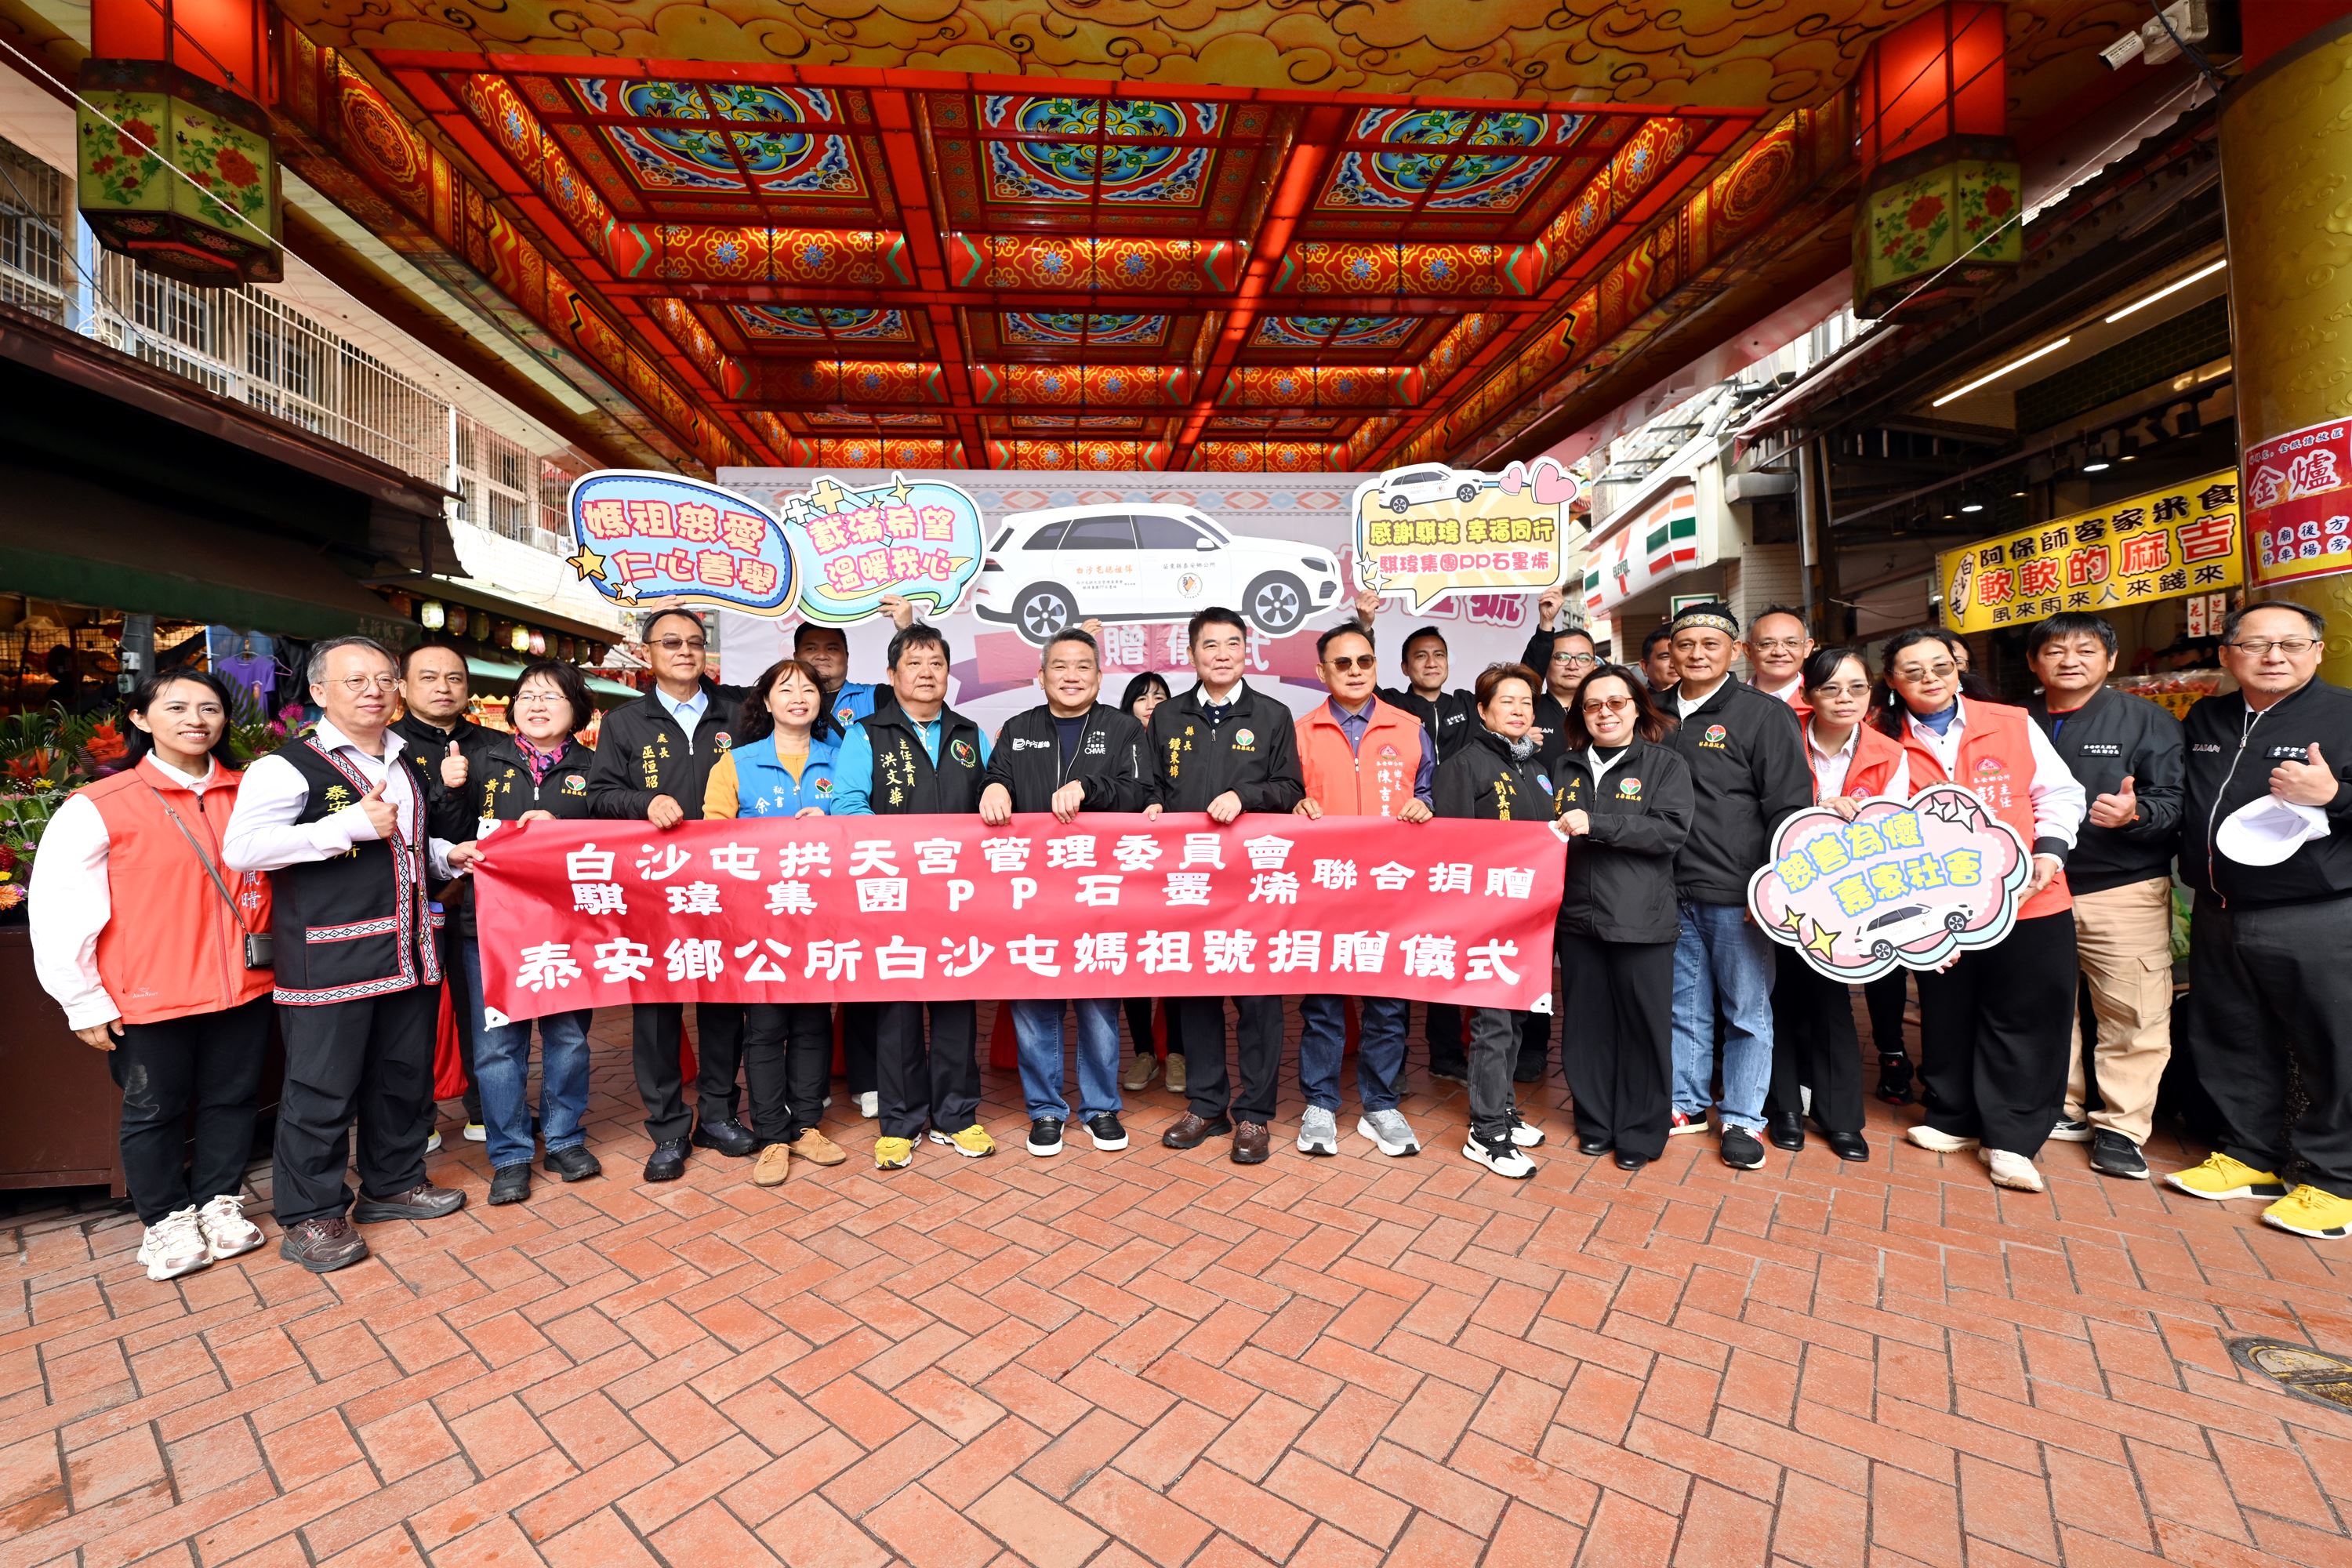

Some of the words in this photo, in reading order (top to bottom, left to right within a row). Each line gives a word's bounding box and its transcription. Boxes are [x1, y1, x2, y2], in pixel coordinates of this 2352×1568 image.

[2250, 450, 2339, 507] 金爐
[582, 499, 765, 557] 媽祖慈愛
[1369, 518, 1461, 546] 感謝騏瑋
[1466, 517, 1554, 543] 幸福同行
[1980, 485, 2237, 568] 阿保師客家米食
[2261, 517, 2347, 547] 在廟後方
[611, 549, 778, 597] 仁心善舉
[823, 546, 954, 594] 溫暖我心
[1380, 551, 1549, 574] 騏瑋集團PP石墨烯
[1977, 514, 2234, 606] 軟軟的麻吉
[2262, 536, 2348, 567] 停車場旁
[1951, 559, 1973, 615] 白沙屯
[1992, 564, 2225, 624] 風來雨來人來錢來
[880, 751, 904, 808] 洪文華
[899, 738, 916, 787] 主任委員
[1999, 783, 2013, 808] 主任
[565, 834, 1295, 881] 白沙屯拱天宮管理委員會
[1312, 858, 1536, 900] 聯合捐贈
[573, 872, 1300, 916] 騏瑋集團PP石墨烯
[1829, 848, 1983, 918] 嘉惠社會
[515, 929, 1522, 993] 泰安鄉公所白沙屯媽祖號捐贈儀式
